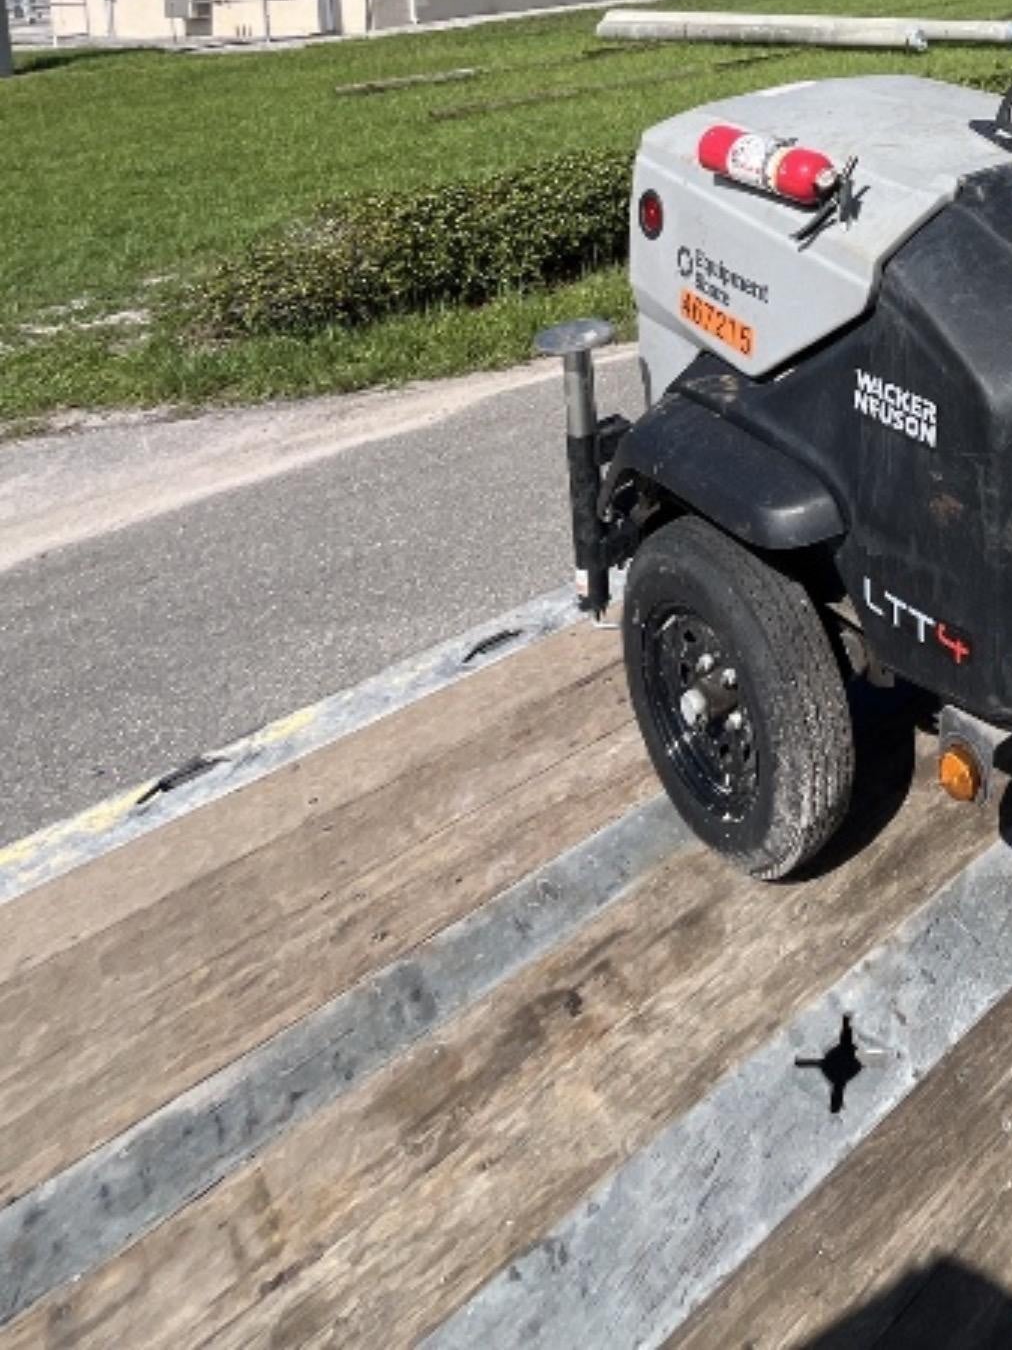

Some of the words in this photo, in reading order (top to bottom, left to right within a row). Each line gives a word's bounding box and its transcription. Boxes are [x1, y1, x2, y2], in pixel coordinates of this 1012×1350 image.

[854, 368, 937, 424] WACKER
[854, 390, 937, 448] NEUSON
[863, 576, 970, 664] LTT4
